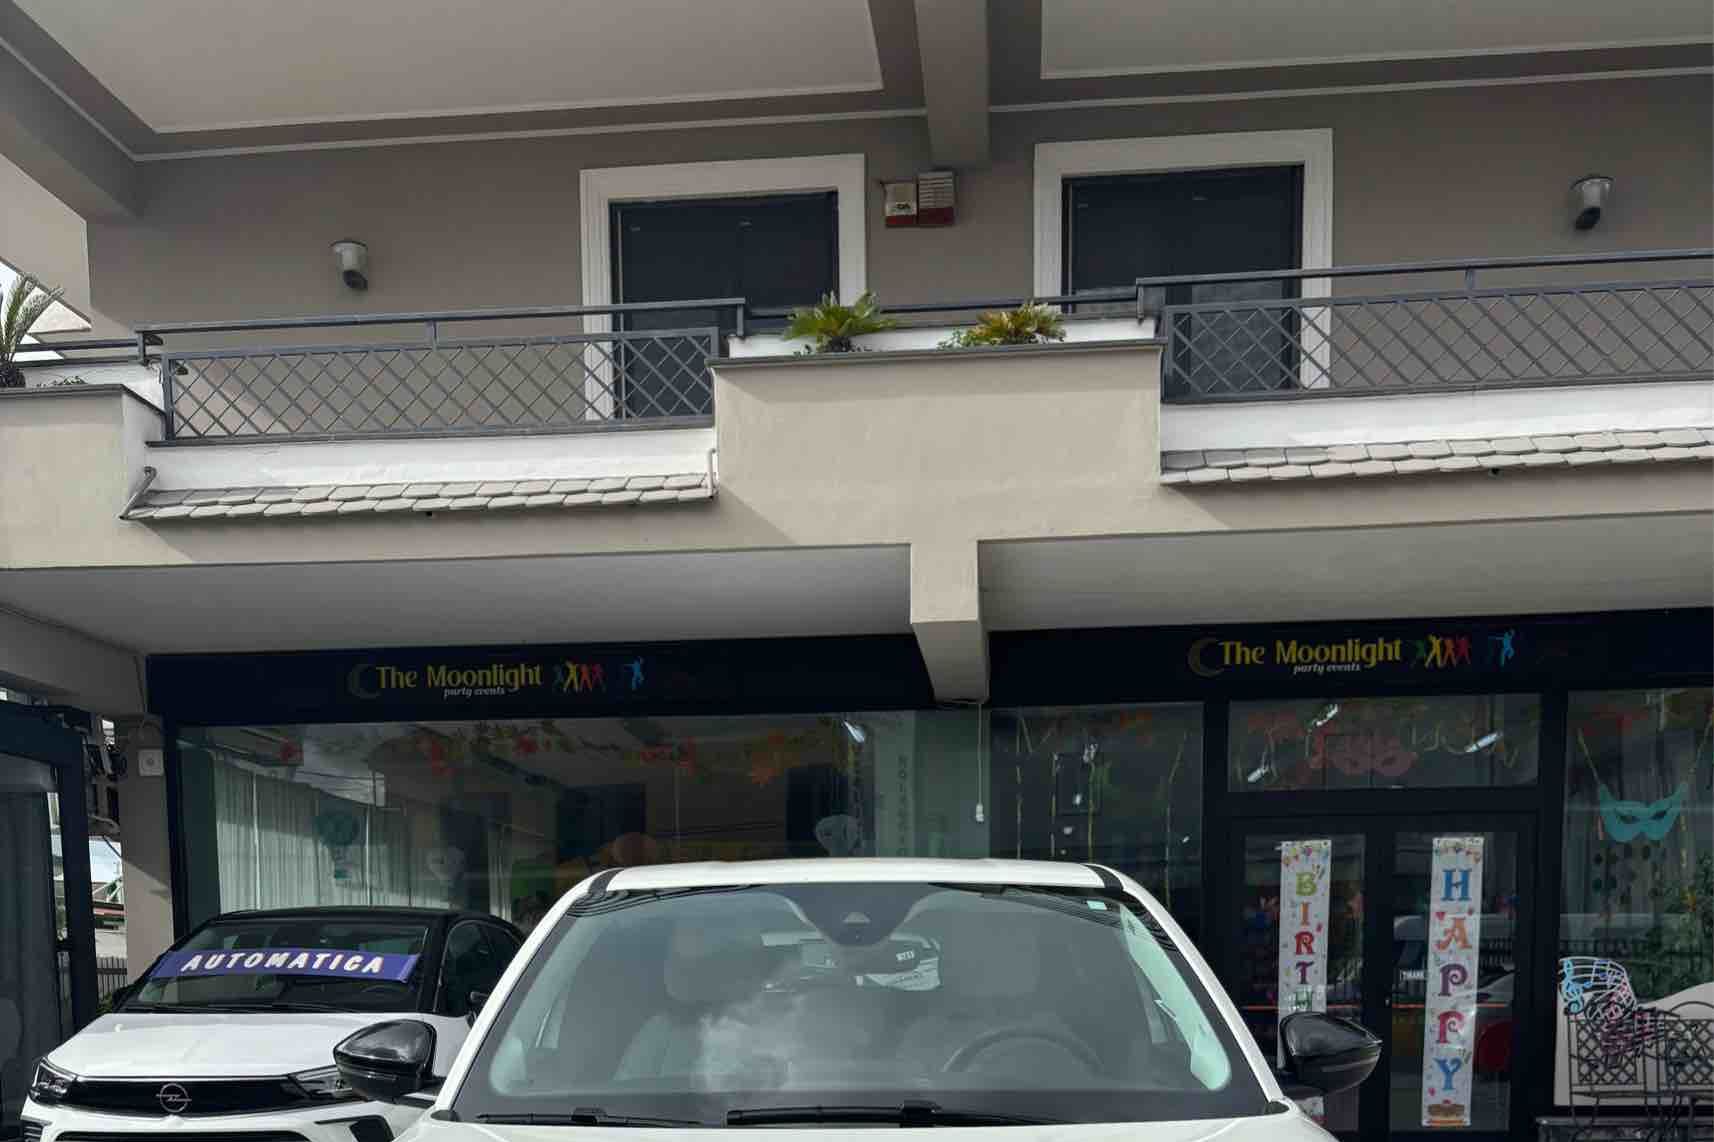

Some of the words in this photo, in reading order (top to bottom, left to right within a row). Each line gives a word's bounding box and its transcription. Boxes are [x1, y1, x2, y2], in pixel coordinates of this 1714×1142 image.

[1218, 641, 1264, 664] The
[1275, 638, 1401, 667] Moonlight
[376, 666, 417, 688] The
[427, 664, 543, 692] Moonlight
[1292, 662, 1325, 675] party
[1326, 662, 1362, 673] events
[443, 687, 473, 699] party
[474, 686, 506, 696] events
[1295, 871, 1317, 1010] BIRTH
[181, 952, 385, 973] AUTOMATICA
[1434, 868, 1472, 1090] HAPPY
